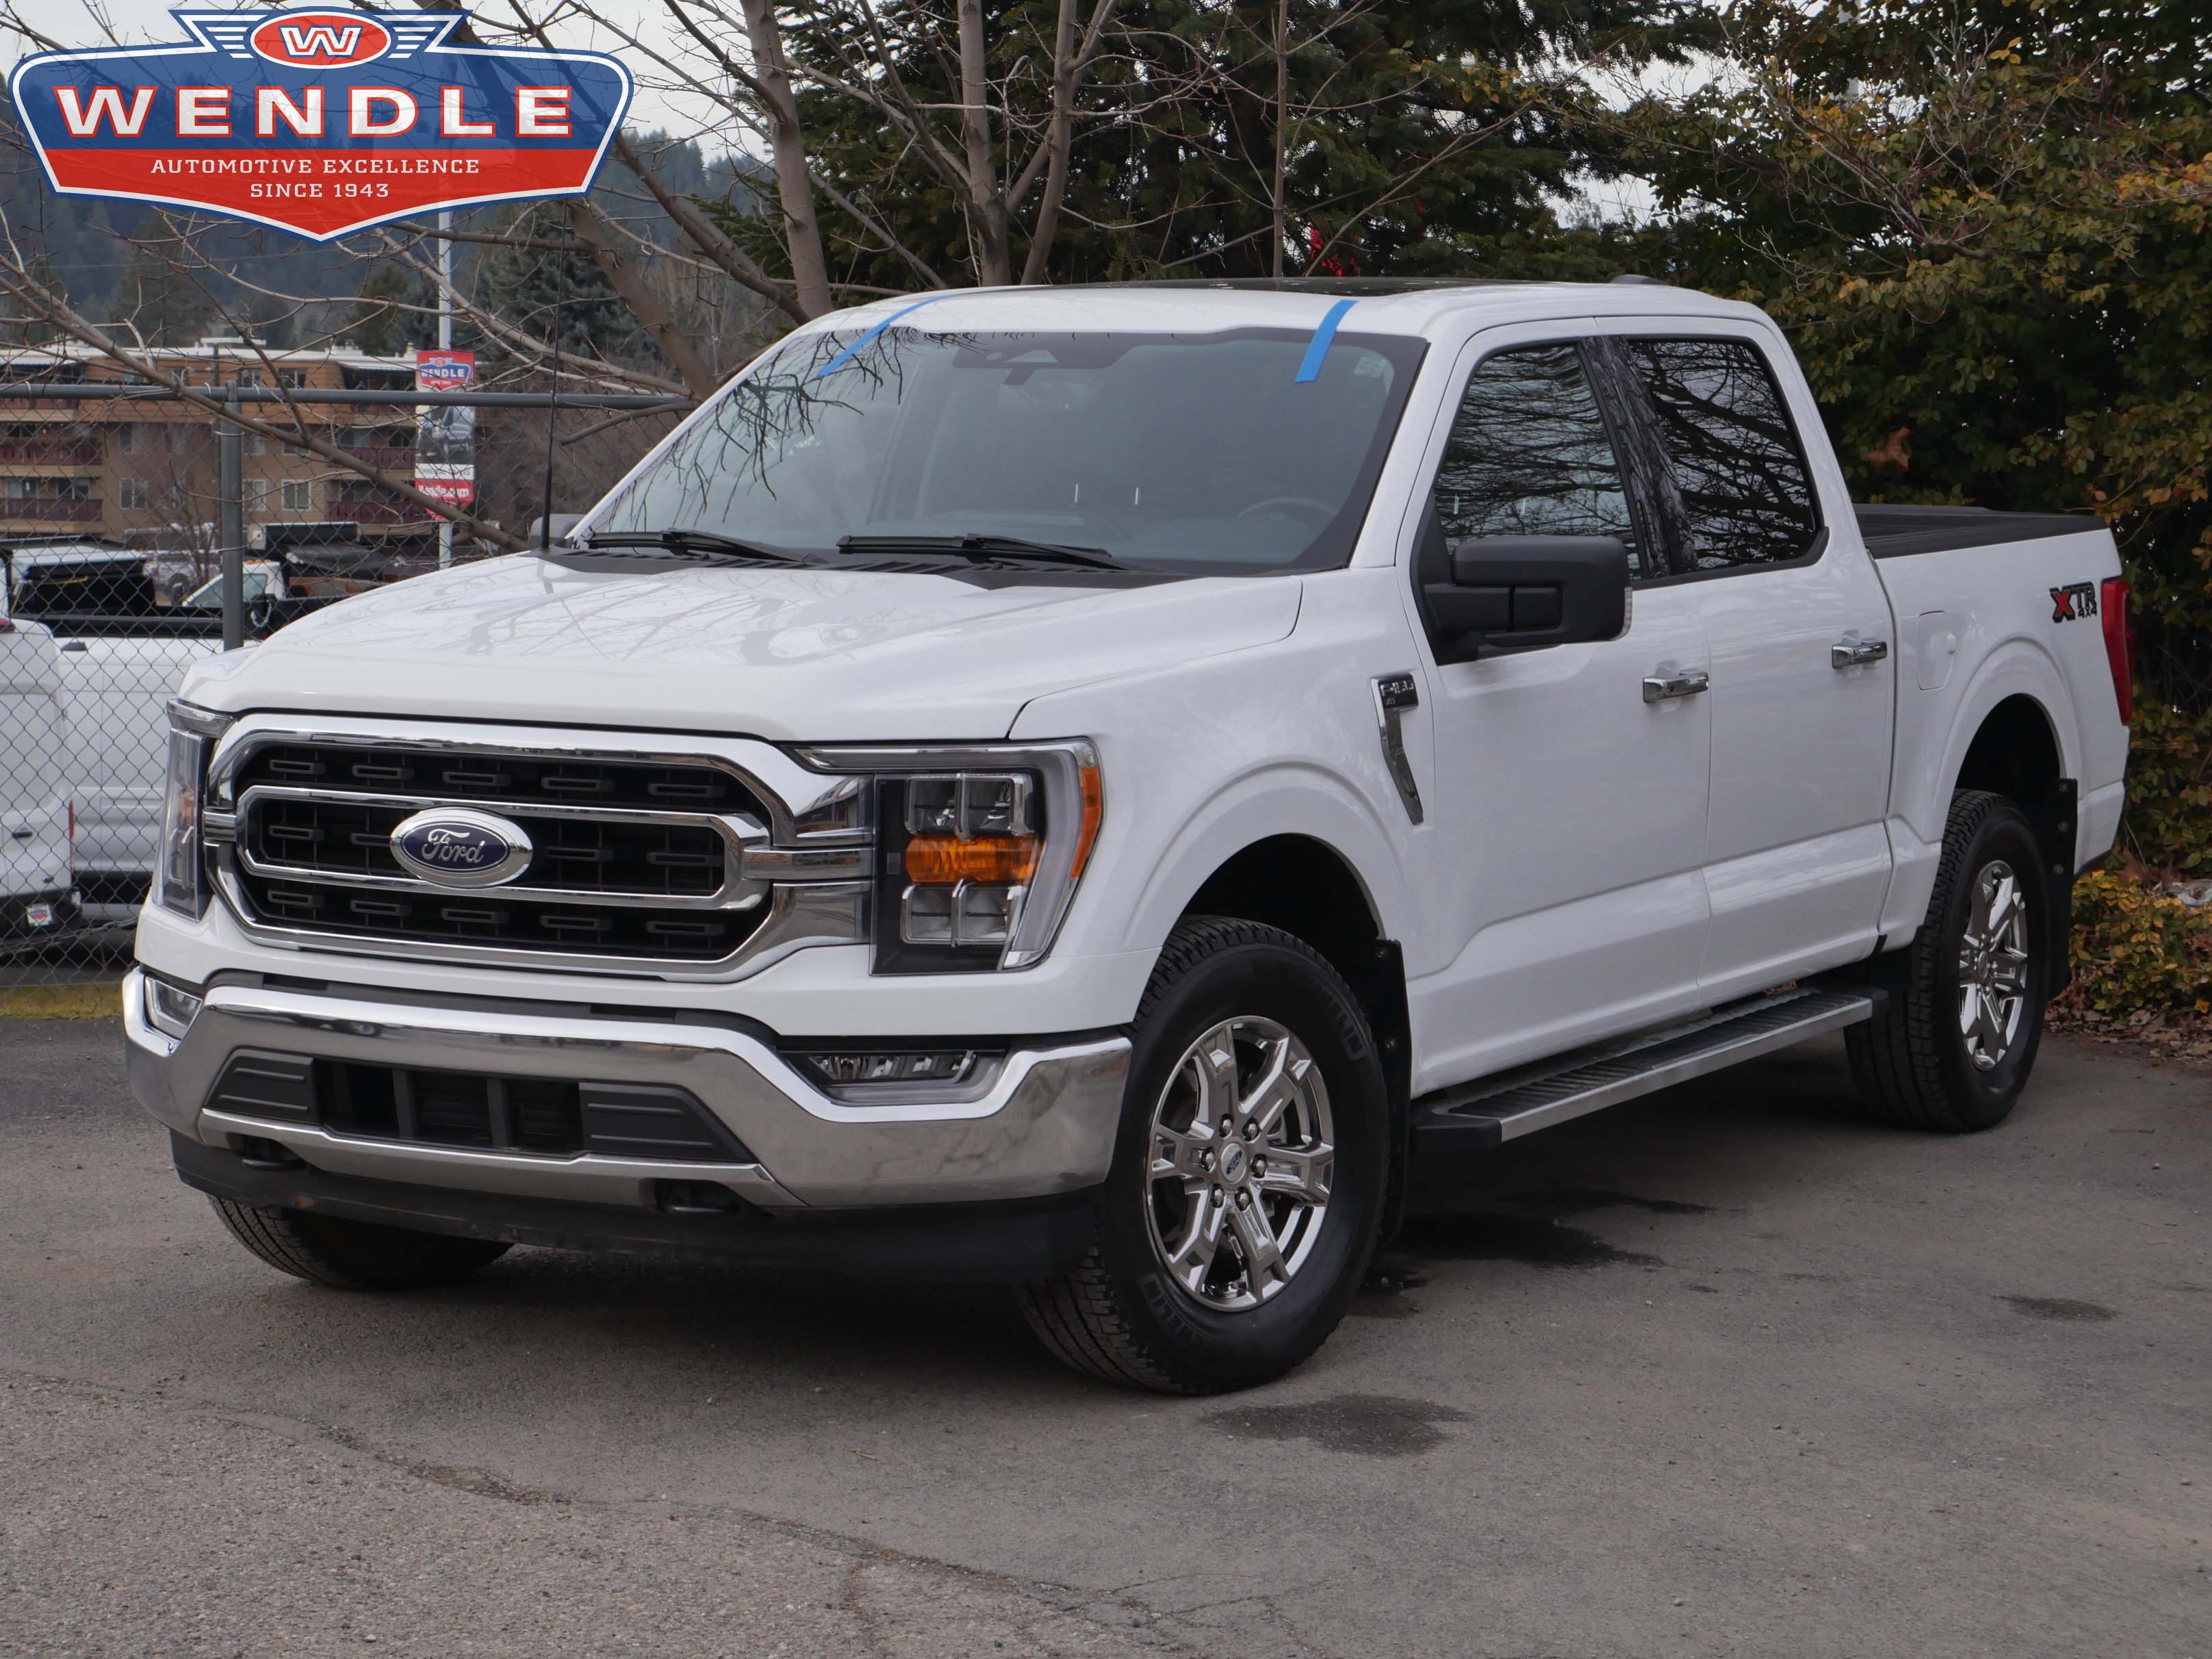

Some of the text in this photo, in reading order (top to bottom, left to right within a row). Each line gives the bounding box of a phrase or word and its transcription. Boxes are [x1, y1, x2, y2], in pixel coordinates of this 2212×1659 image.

[421, 368, 465, 377] WENDLE
[2049, 581, 2097, 624] XTR
[421, 828, 485, 864] Ford
